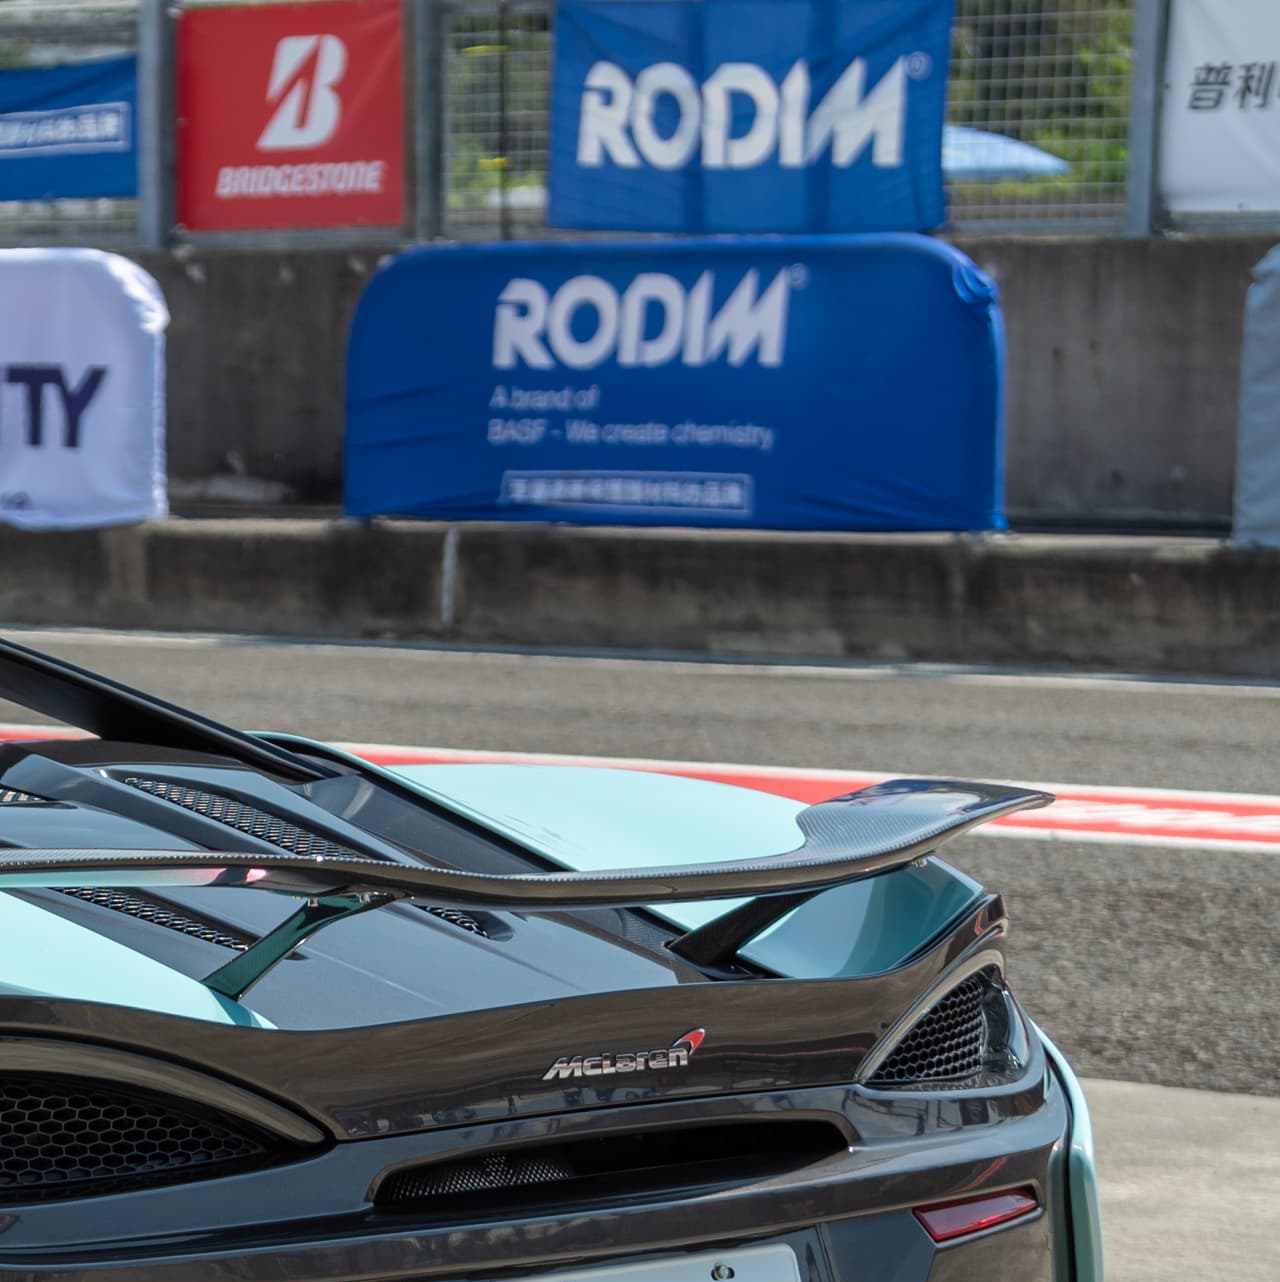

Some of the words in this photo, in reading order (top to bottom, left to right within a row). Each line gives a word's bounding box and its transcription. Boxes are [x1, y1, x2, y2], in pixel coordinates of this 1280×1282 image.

[1187, 61, 1280, 111] 普利
[215, 160, 385, 199] BRIDGESTONE
[492, 268, 792, 371] RODIM
[542, 1045, 691, 1081] McLaren
